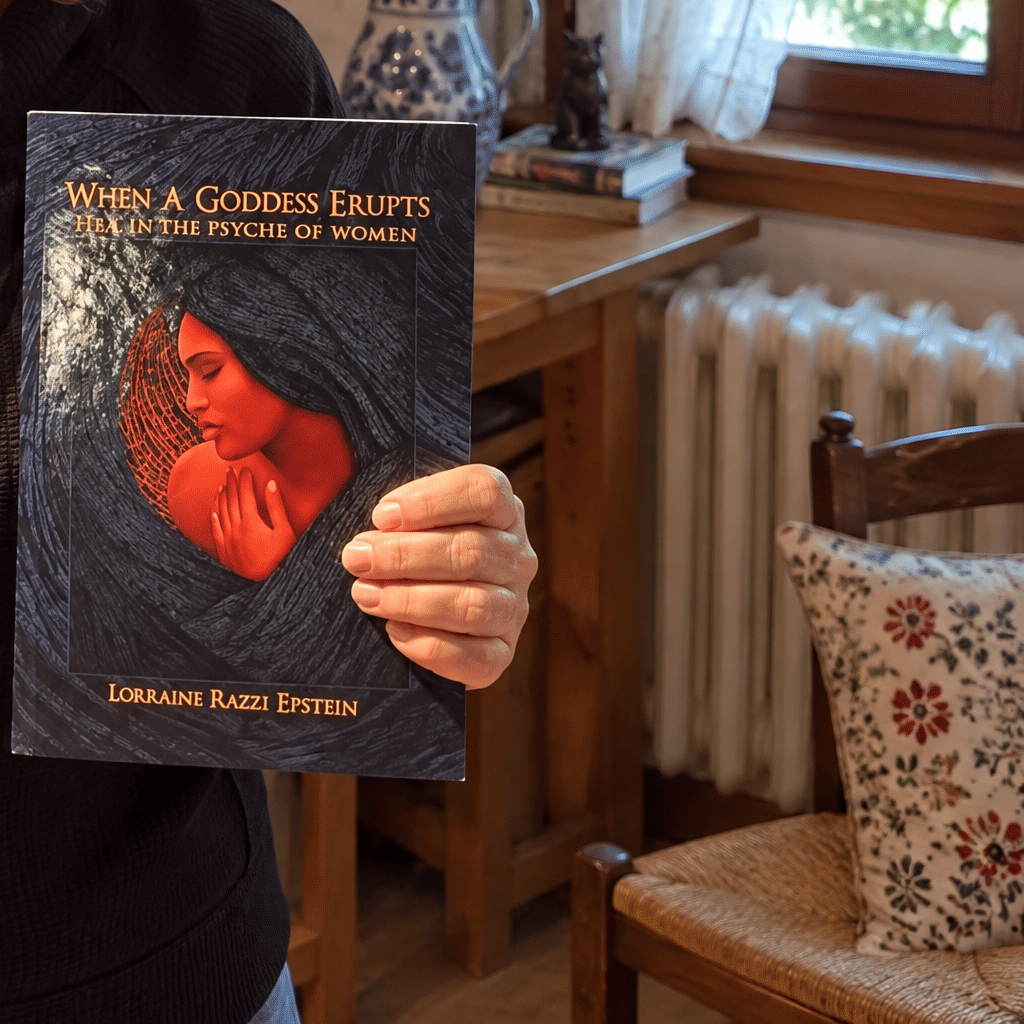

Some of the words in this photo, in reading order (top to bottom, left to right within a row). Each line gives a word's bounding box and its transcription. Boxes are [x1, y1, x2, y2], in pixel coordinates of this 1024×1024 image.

[64, 181, 152, 210] WHEN
[160, 185, 185, 212] A
[195, 185, 319, 215] GODDESS
[329, 189, 431, 218] ERUPTS
[129, 218, 153, 234] IN
[158, 219, 201, 236] THE
[207, 220, 288, 239] PSYCHE
[294, 224, 323, 240] OF
[329, 225, 417, 243] WOMEN
[108, 683, 203, 707] LORRAINE
[209, 688, 269, 711] RAZZI
[276, 691, 358, 717] EPSTEIN
